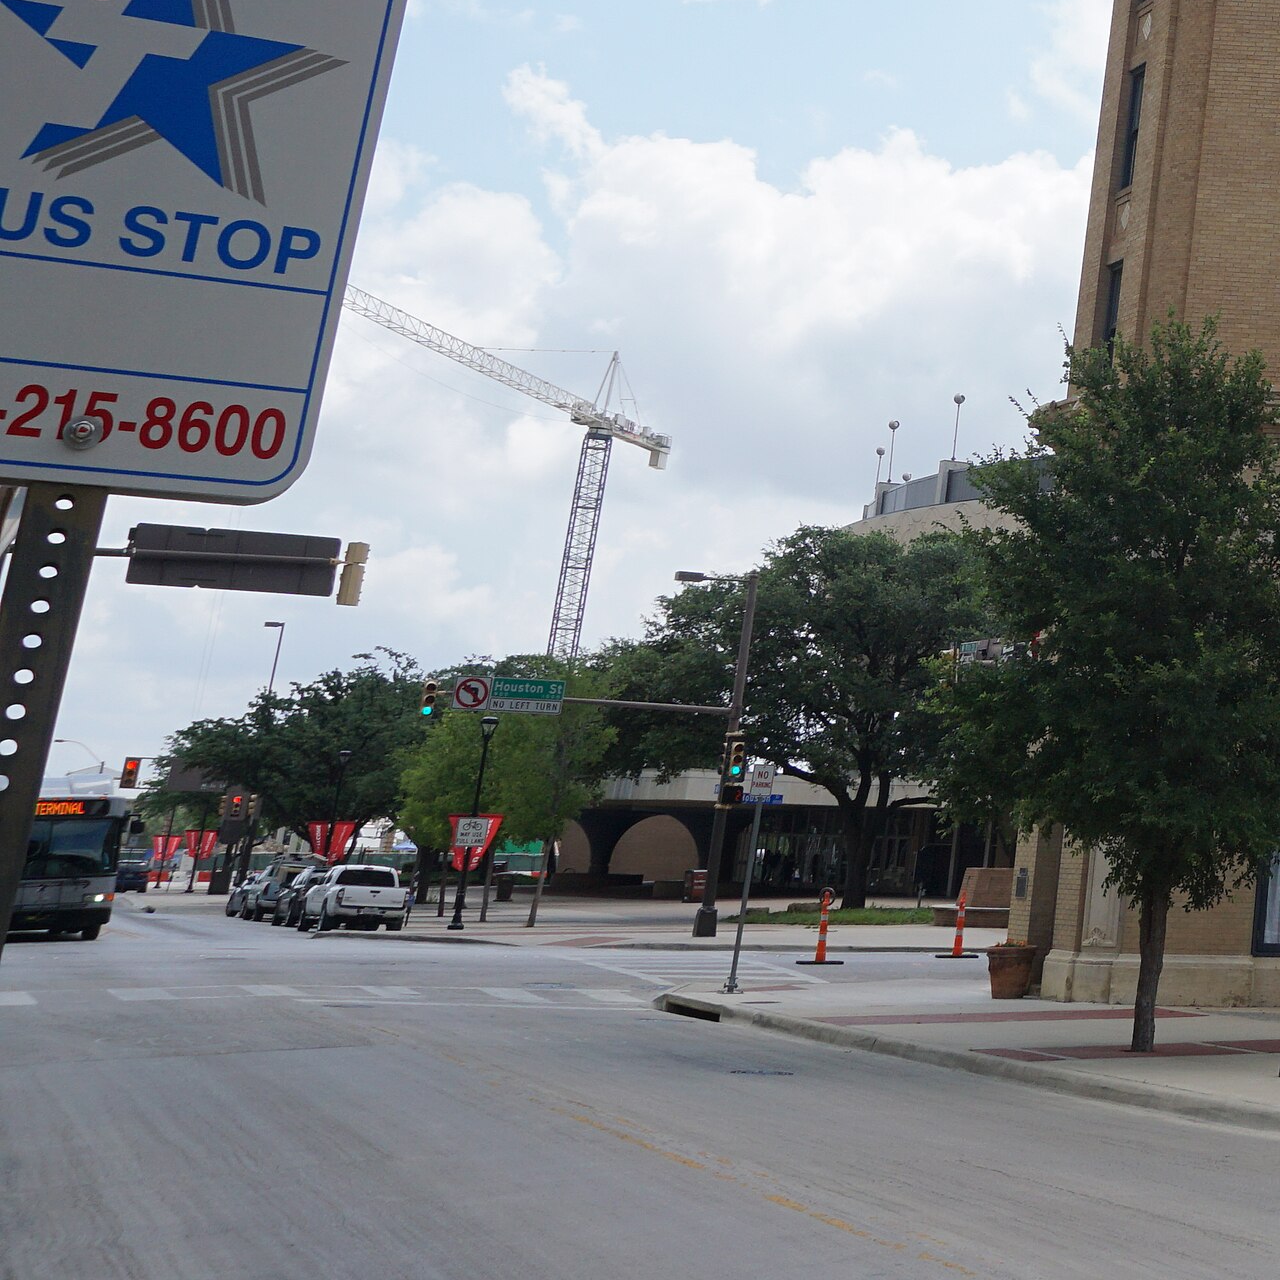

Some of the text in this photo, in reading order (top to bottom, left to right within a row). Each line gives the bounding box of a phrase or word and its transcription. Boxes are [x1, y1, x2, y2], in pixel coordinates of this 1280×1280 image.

[119, 205, 322, 275] STOP
[494, 681, 563, 694] Houston St
[492, 700, 504, 708] NO
[536, 703, 558, 711] TURN
[757, 771, 769, 779] NO
[35, 802, 85, 816] TERMINAL
